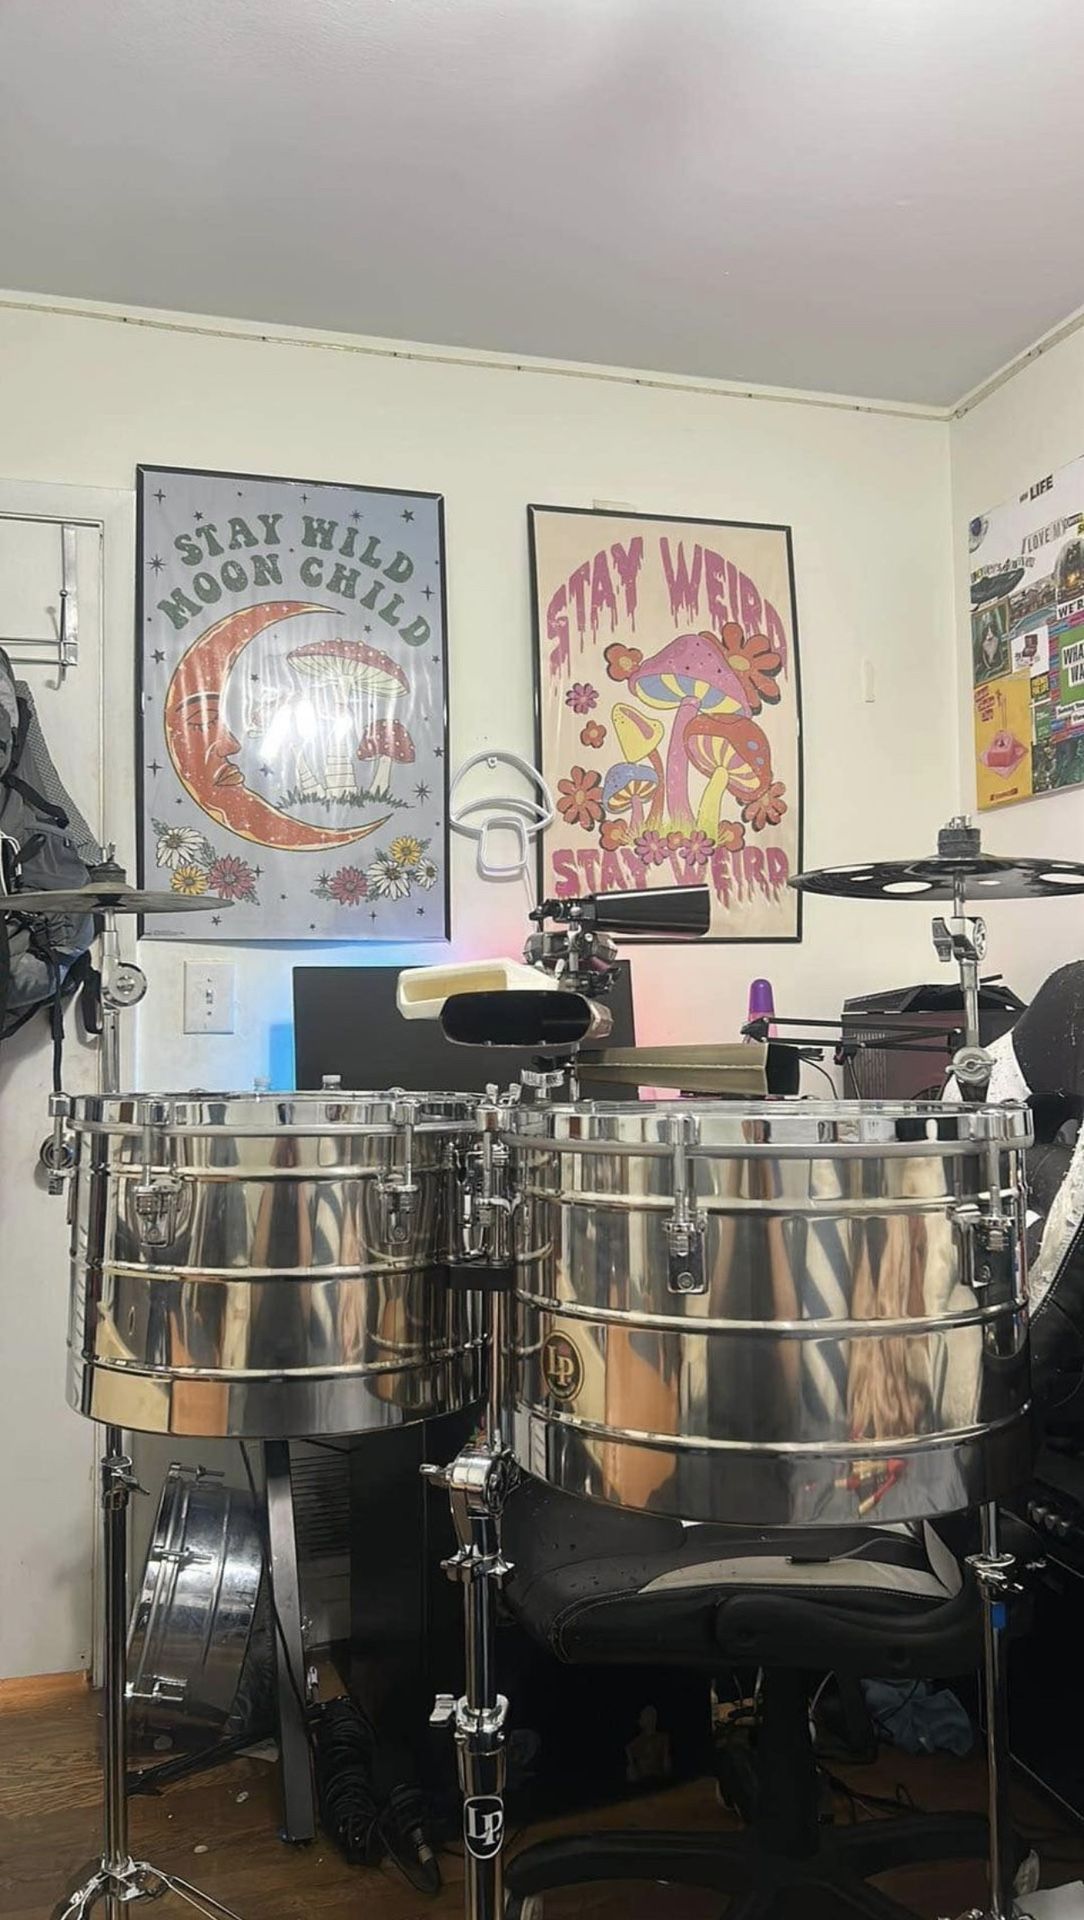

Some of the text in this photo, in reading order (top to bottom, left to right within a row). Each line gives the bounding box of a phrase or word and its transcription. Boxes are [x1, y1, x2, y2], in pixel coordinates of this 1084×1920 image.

[1030, 474, 1053, 501] LIFE
[173, 513, 415, 585] STAY WILD
[1028, 527, 1050, 553] LOVE
[156, 553, 431, 648] MOON CHILD
[546, 536, 789, 684] STAY WEIRD
[552, 846, 790, 908] STAY WEIRD
[546, 1345, 574, 1386] LP
[467, 1806, 503, 1846] LP
